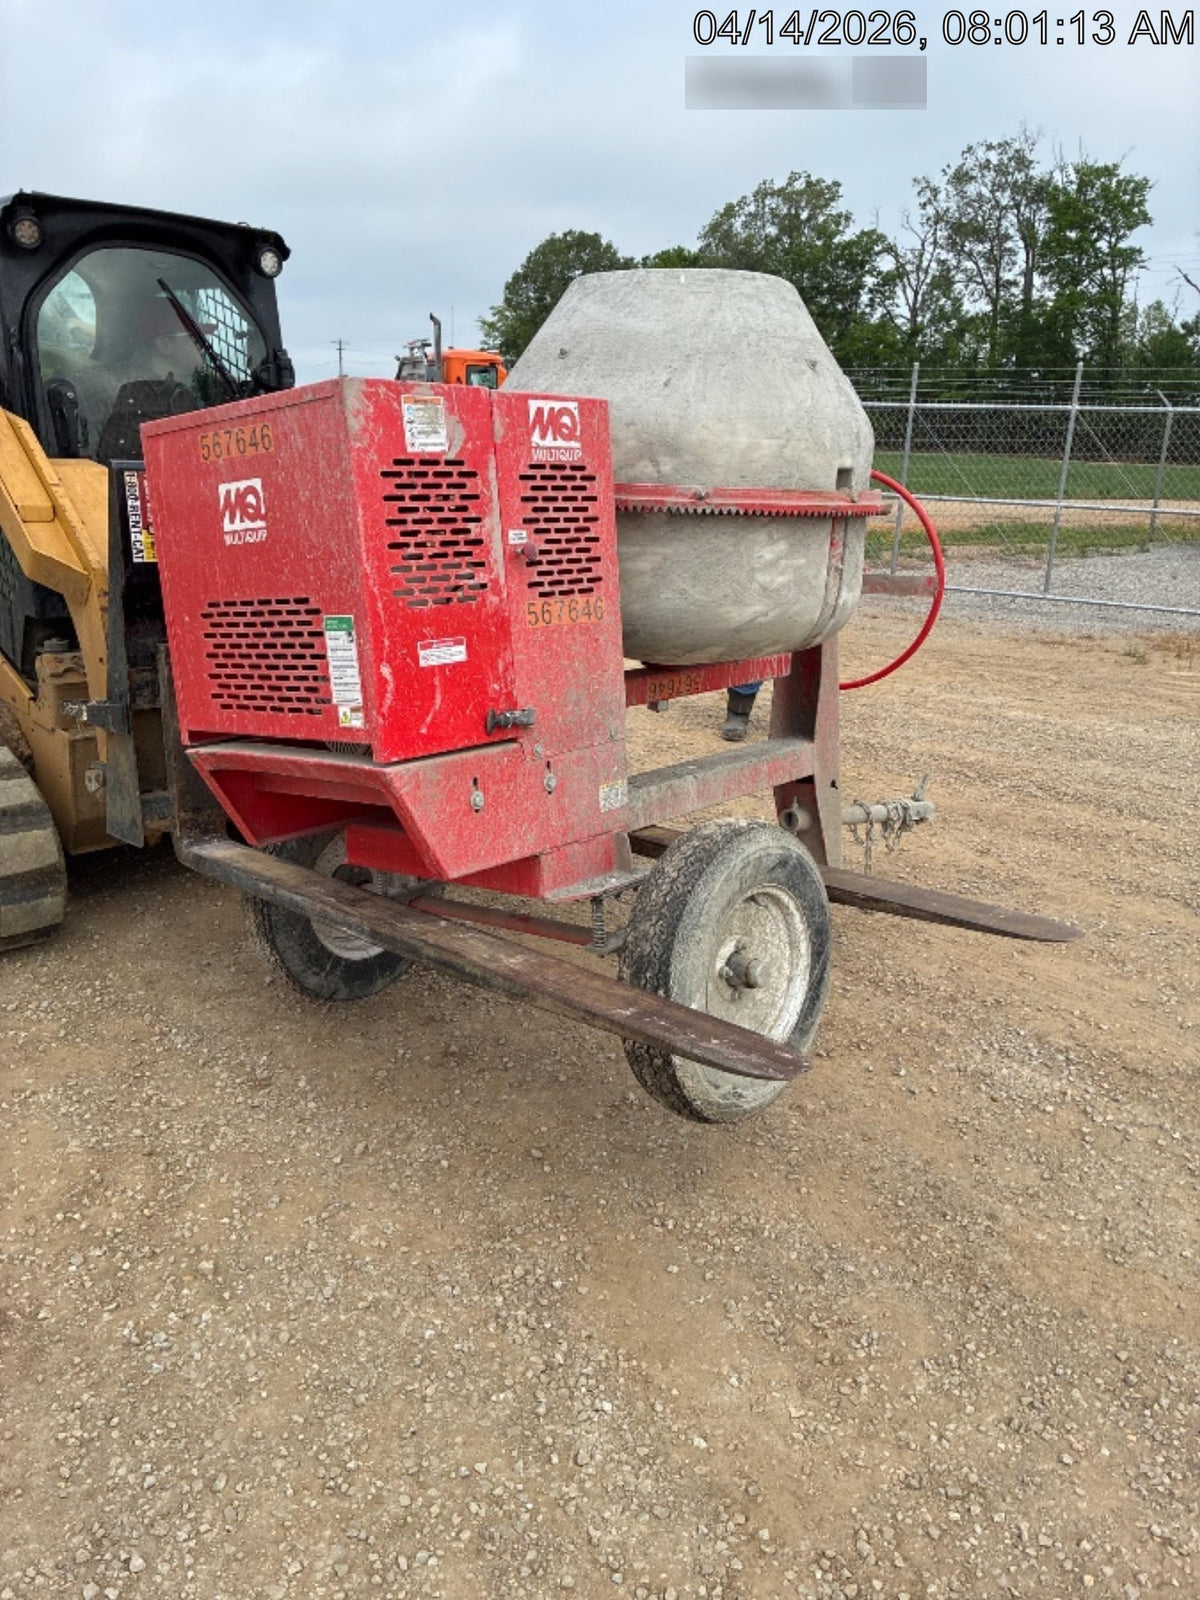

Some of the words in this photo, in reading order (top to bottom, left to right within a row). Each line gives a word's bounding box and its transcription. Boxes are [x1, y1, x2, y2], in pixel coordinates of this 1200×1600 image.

[201, 424, 272, 461] 567646
[529, 404, 581, 443] MQ
[219, 483, 265, 525] MQ
[528, 597, 603, 626] 567646
